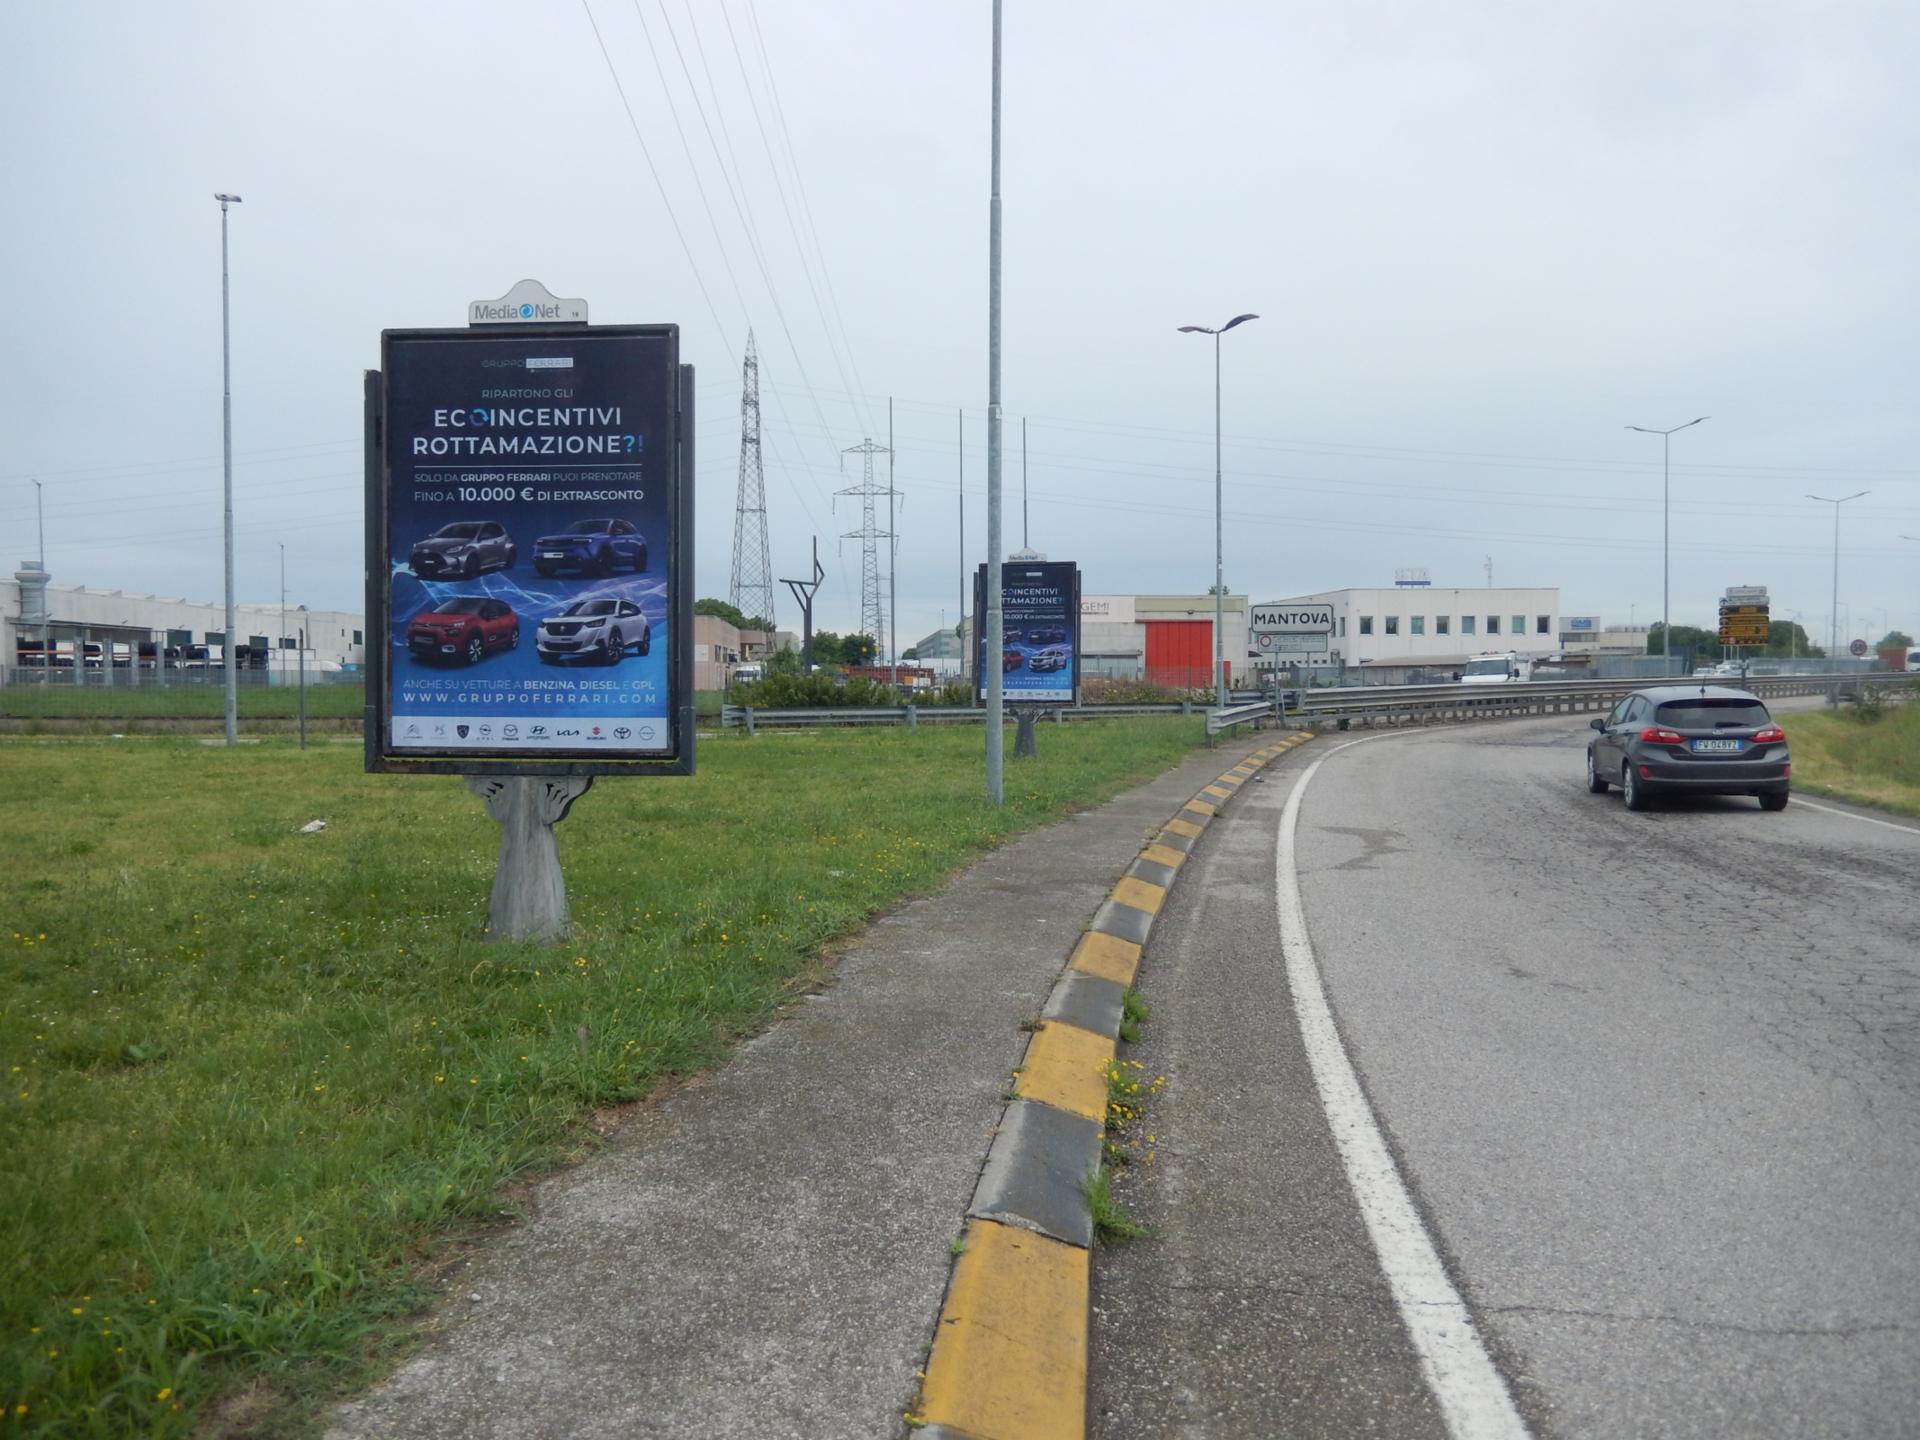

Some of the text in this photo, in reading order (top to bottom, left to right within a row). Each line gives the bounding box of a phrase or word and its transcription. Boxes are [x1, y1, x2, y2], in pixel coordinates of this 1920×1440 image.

[474, 304, 518, 319] Media
[534, 303, 561, 318] Net
[481, 387, 574, 399] RIPARTONO GLI
[413, 434, 644, 455] ROTTAMAZIONE?!
[414, 471, 643, 483] SOLO DA GRUPPO FERRARI PUOI PRENOTARE
[414, 487, 644, 502] FINO A 10.000 € DI EXTRASCONTO
[1254, 612, 1330, 625] MANTOVA
[403, 679, 441, 689] ANCHE
[444, 679, 459, 689] SU
[461, 679, 512, 689] VETTURE
[513, 680, 522, 689] A
[580, 680, 620, 690] DIESEL
[624, 680, 629, 690] E
[631, 680, 655, 690] GPL
[403, 693, 656, 704] WWW.GRUPPOFERRARI.COM
